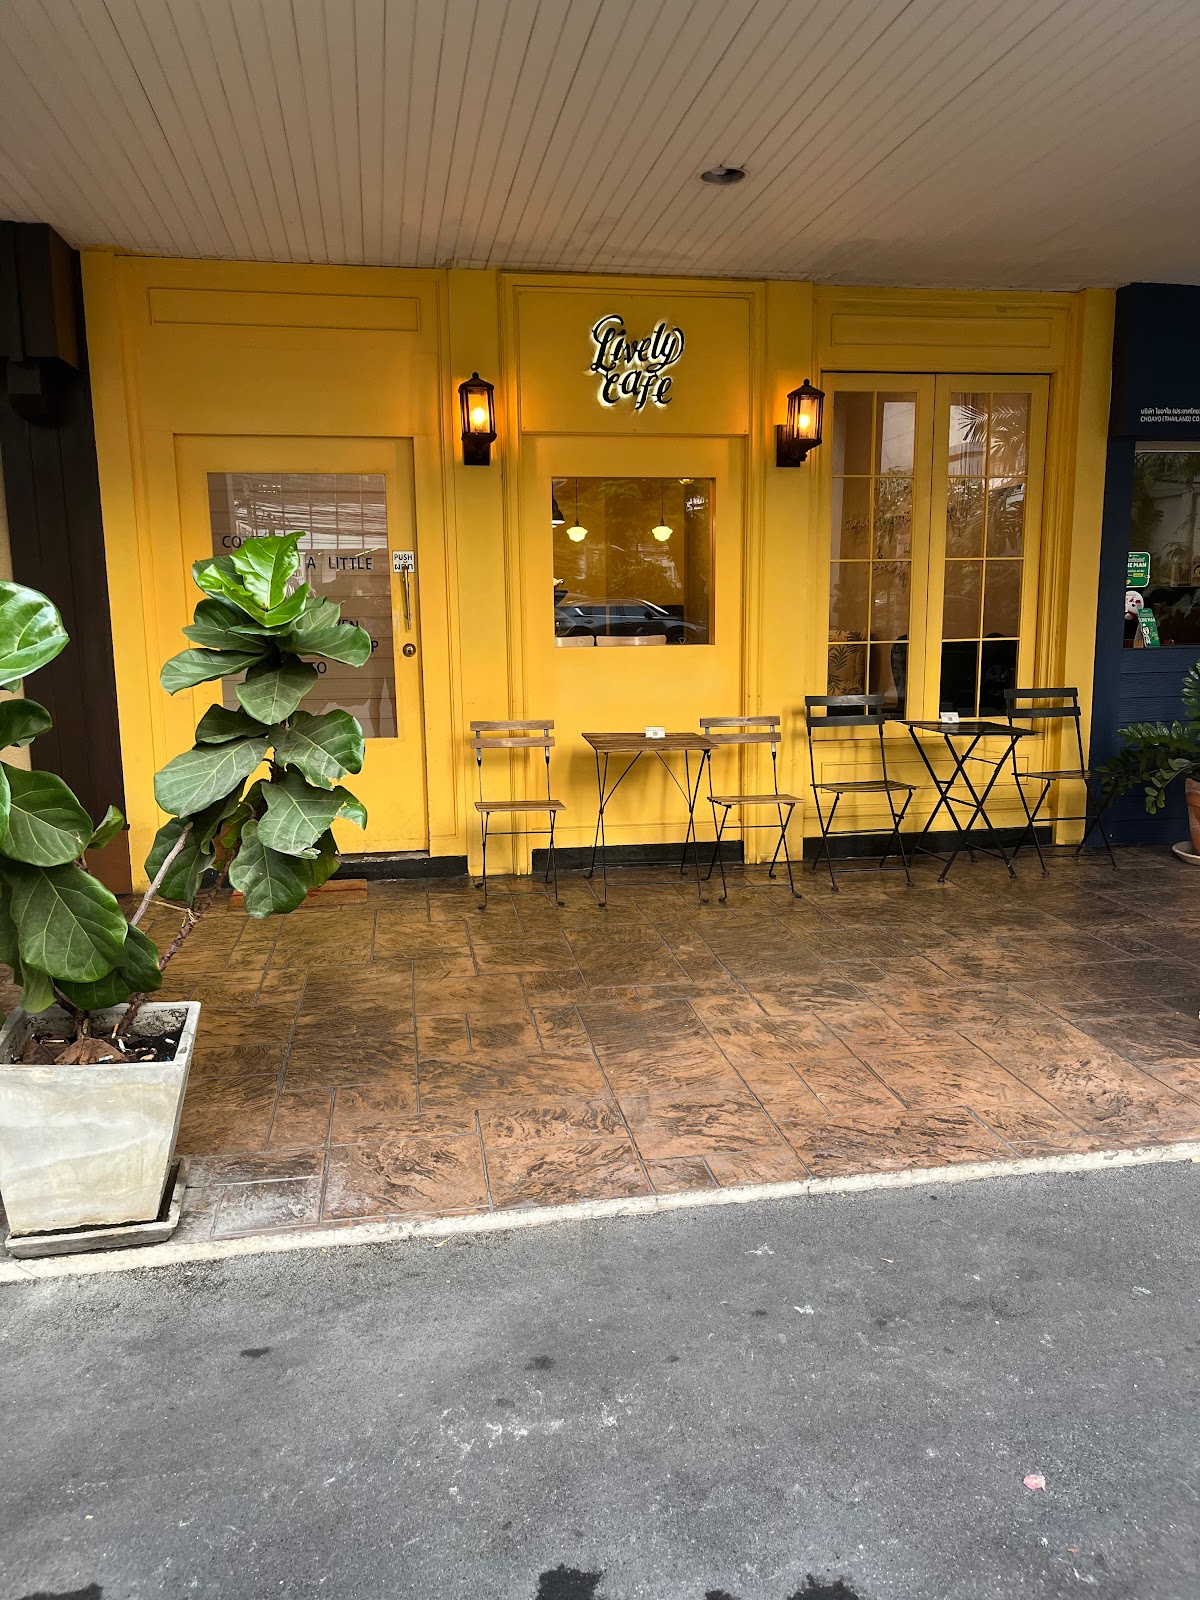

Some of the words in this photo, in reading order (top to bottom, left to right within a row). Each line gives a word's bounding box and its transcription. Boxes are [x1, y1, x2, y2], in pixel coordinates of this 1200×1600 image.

[591, 314, 684, 373] Lively
[307, 556, 316, 569] A
[328, 556, 373, 570] LITTLE
